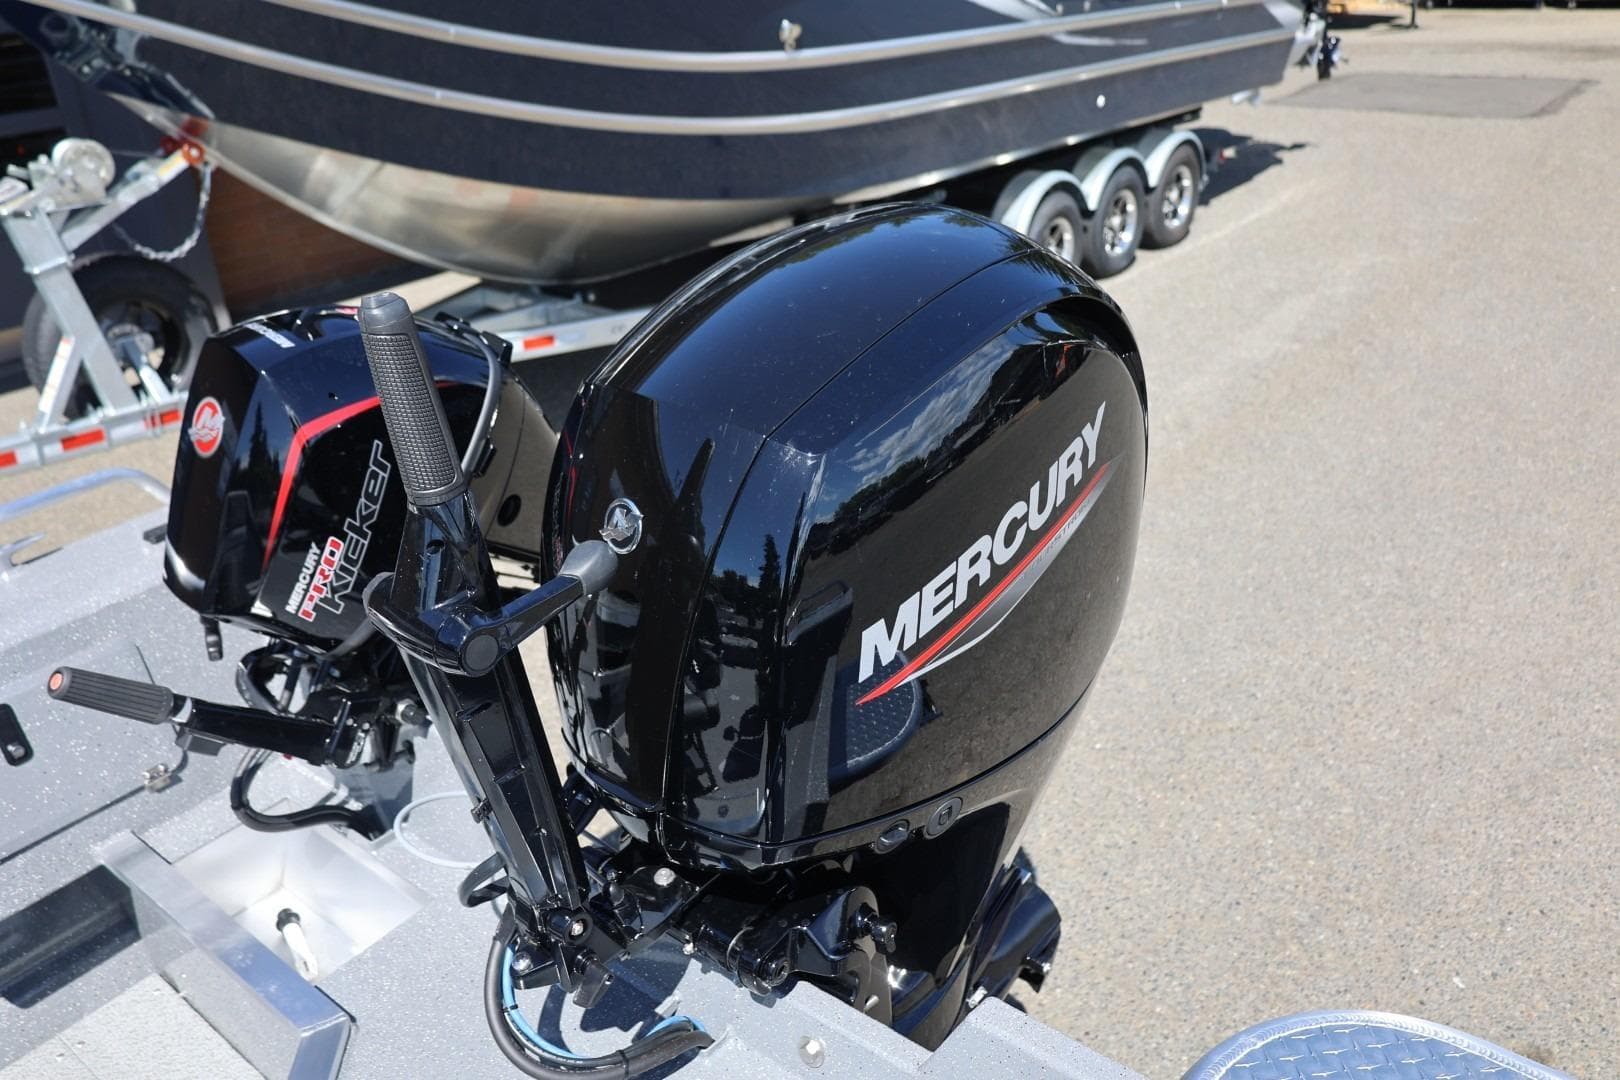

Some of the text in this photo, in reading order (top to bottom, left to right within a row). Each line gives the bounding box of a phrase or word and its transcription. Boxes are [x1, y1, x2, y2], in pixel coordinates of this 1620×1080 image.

[285, 541, 321, 614] MERCURY
[298, 536, 344, 622] PRO
[858, 401, 1106, 683] MERCURY
